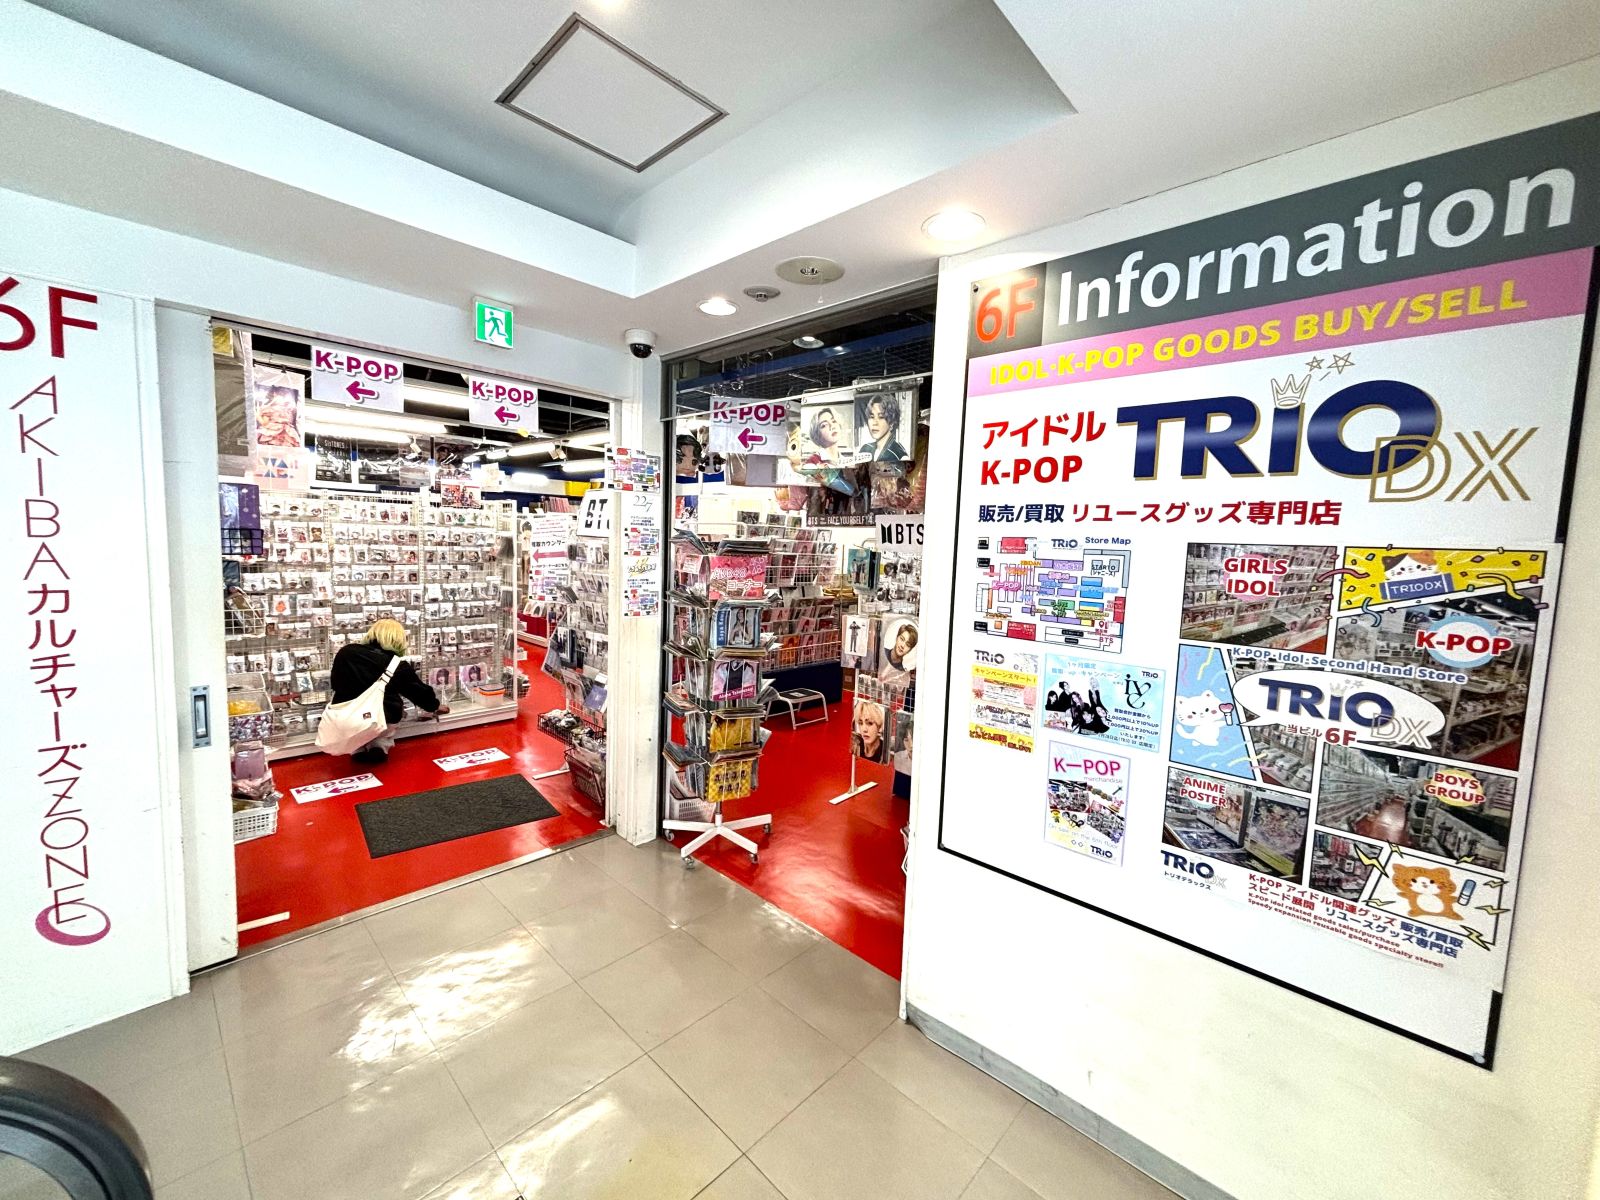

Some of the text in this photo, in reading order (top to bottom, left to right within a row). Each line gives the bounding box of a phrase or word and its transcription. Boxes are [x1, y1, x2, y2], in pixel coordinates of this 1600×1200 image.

[1058, 167, 1576, 327] Information
[976, 277, 1038, 343] 6F
[1153, 319, 1281, 361] GOODS
[1293, 279, 1529, 333] BUY/SELL
[315, 349, 399, 381] K-POP
[471, 380, 536, 405] K-POP
[713, 401, 785, 423] K-POP
[983, 411, 1106, 450] アイドル
[981, 455, 1083, 485] K-POP
[1369, 427, 1540, 503] DX
[585, 498, 609, 530] BT
[978, 499, 1343, 527] 販売/買取 リユースグッズ専門店
[895, 523, 925, 545] BTS
[1085, 536, 1109, 544] Store
[1111, 537, 1131, 546] Map
[1223, 557, 1288, 575] GIRLS
[1227, 577, 1280, 597] IDOL
[1416, 629, 1512, 656] K-POP
[1371, 662, 1413, 677] Hand
[1417, 667, 1466, 683] Store
[1287, 724, 1357, 746] 当ビル 6F
[1371, 712, 1433, 748] DX
[1183, 777, 1226, 795] ANIME
[1425, 784, 1485, 804] GROUP
[1434, 772, 1479, 790] BOYS
[1180, 788, 1226, 807] POSTER
[1248, 892, 1270, 902] K-POP
[1285, 901, 1312, 917] related
[1313, 911, 1337, 926] goods
[1338, 920, 1400, 947] sales/purchase
[1249, 873, 1464, 949] K-POP アイドル関連グッズ 販売/買取
[1249, 883, 1458, 958] スピード展開 リユースグッズ専門店
[1248, 898, 1273, 911] Speedy
[1273, 906, 1312, 923] expansion
[1313, 919, 1347, 936] reusable
[1348, 931, 1373, 946] goods
[1374, 942, 1413, 960] specialty
